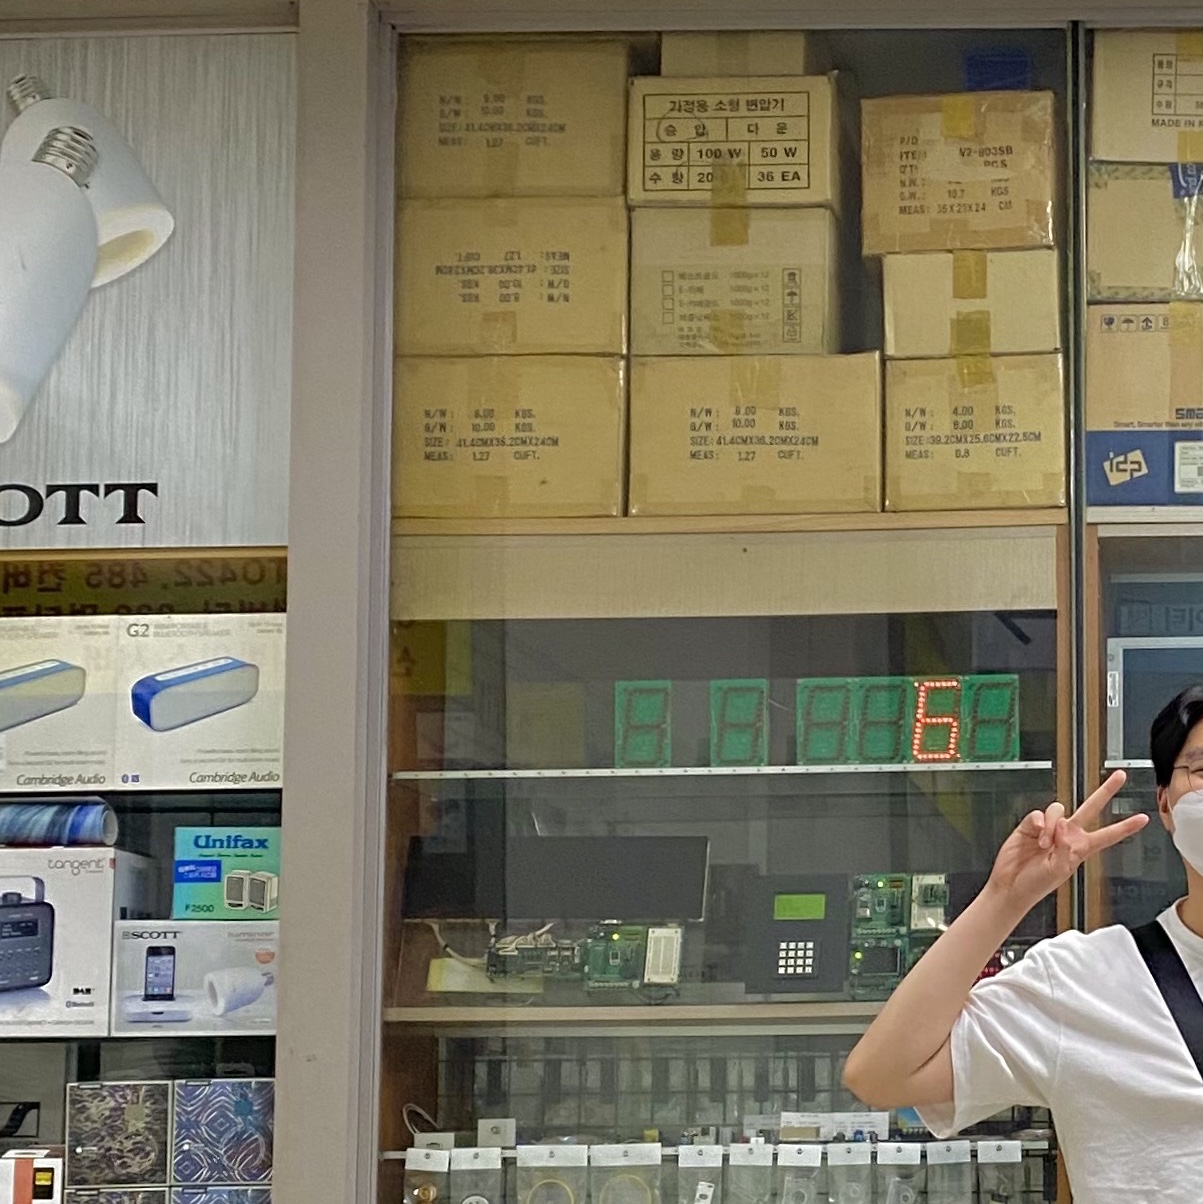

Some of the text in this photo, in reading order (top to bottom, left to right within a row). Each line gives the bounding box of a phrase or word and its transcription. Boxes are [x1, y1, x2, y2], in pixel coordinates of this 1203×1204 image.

[669, 100, 708, 113] 가정용
[746, 98, 785, 112] 변압기
[1152, 119, 1181, 128] MADE
[1184, 119, 1196, 128] IN
[781, 171, 801, 182] EA
[126, 622, 150, 638] G2
[16, 773, 106, 787] Cambridge Audio
[189, 770, 281, 785] Cambridge Audio
[193, 834, 269, 850] Unifax
[48, 857, 104, 876] tangent
[131, 931, 180, 940] SCOTT
